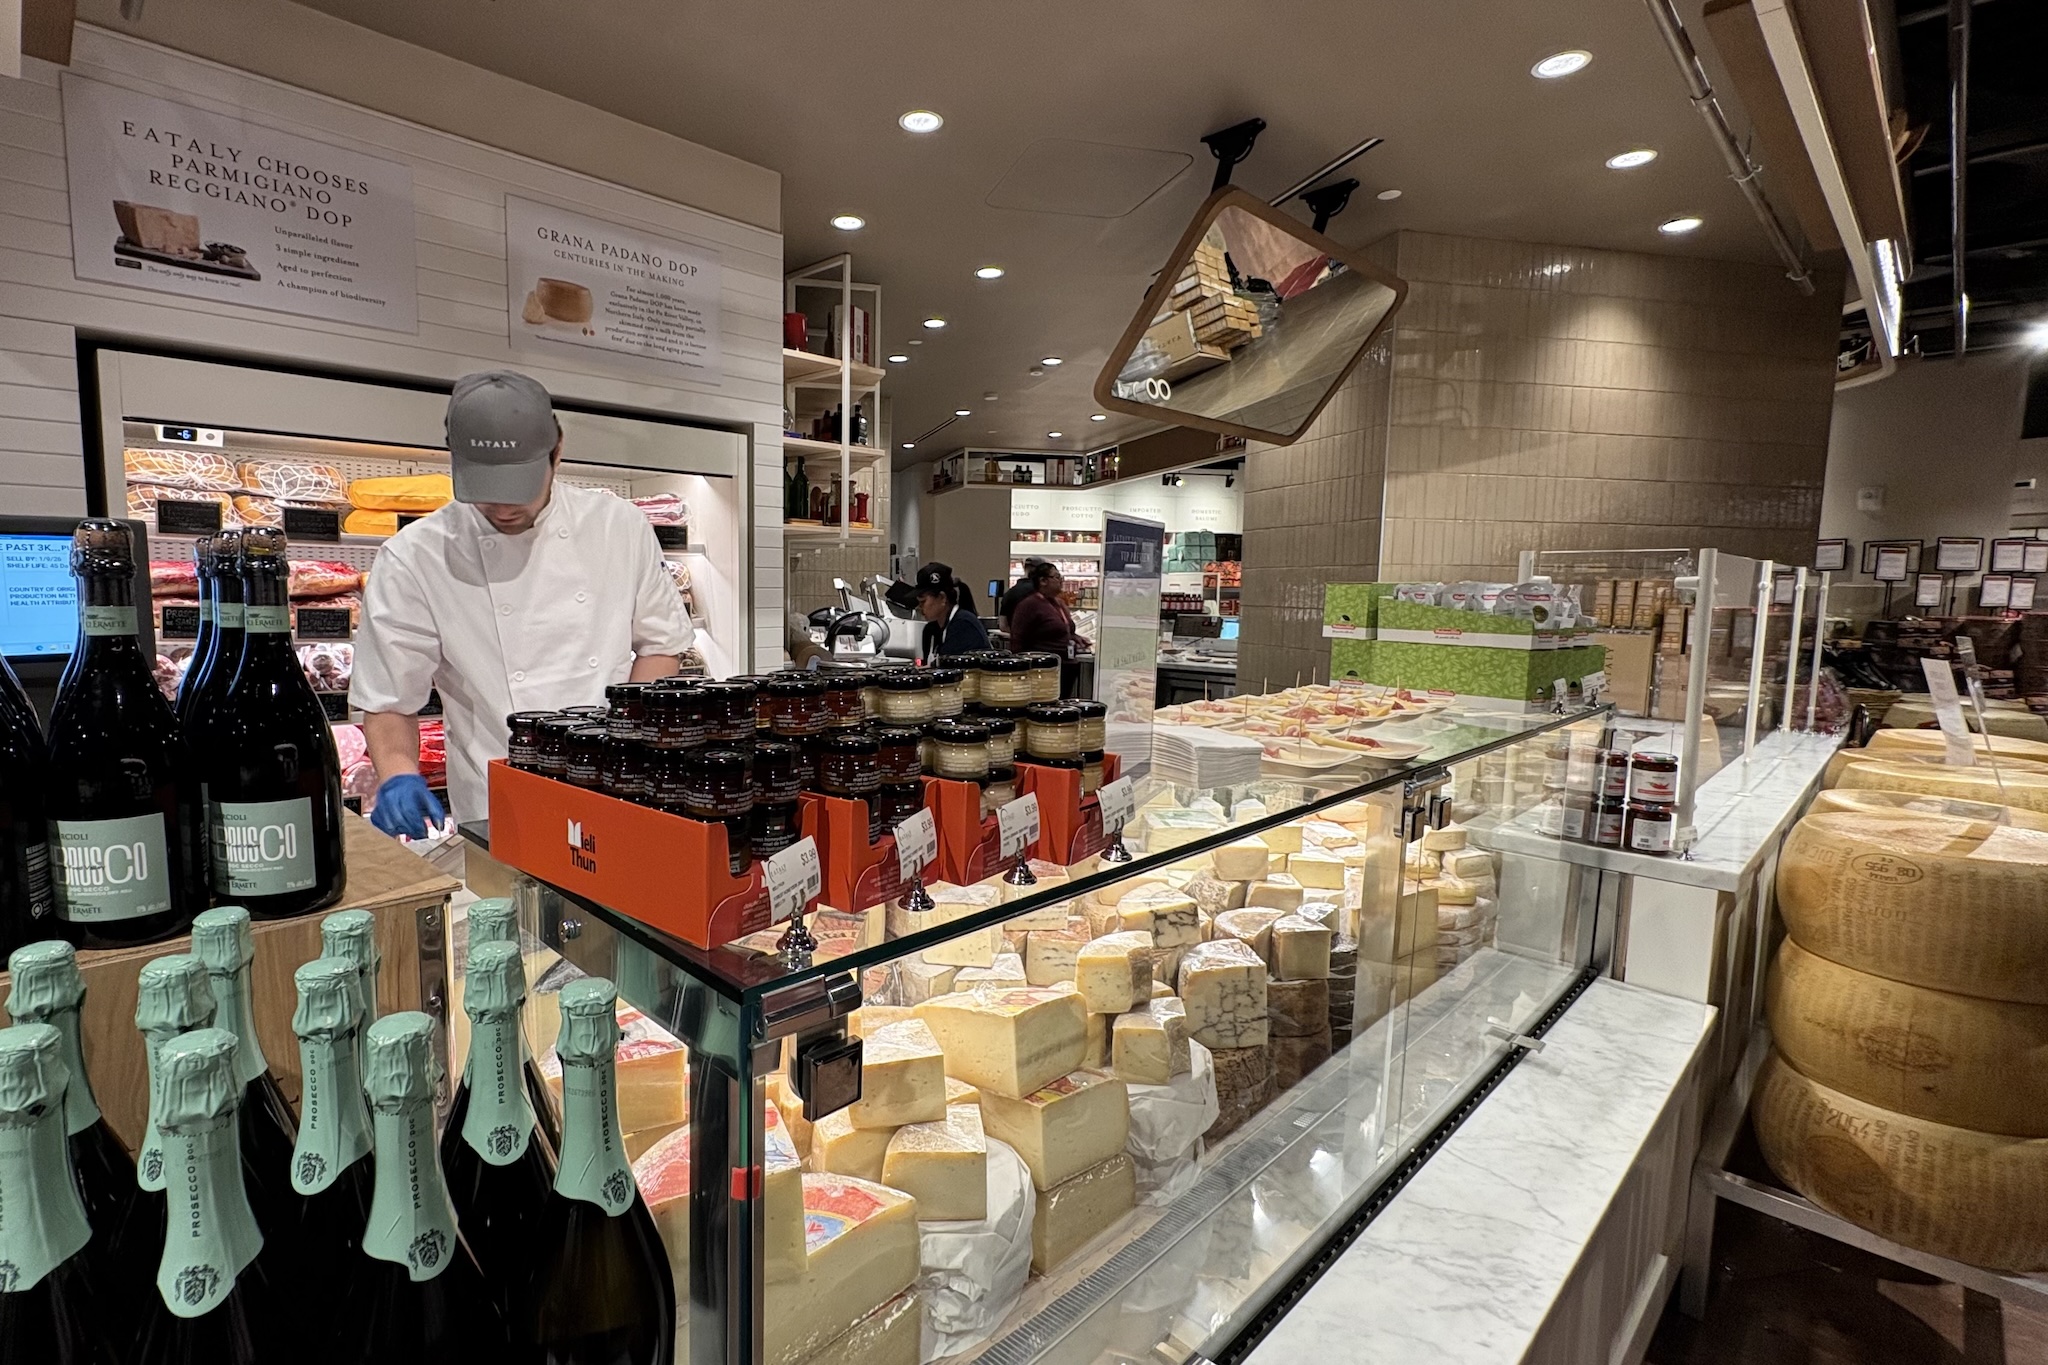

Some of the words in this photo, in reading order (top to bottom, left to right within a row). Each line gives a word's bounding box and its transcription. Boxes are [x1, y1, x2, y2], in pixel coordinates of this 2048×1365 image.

[122, 120, 243, 163] EATALY
[257, 156, 369, 195] CHOOSES
[171, 153, 332, 205] PARMIGIANO
[306, 206, 353, 228] DOP
[274, 226, 328, 244] Unparalleled
[331, 238, 353, 249] flavor
[283, 247, 311, 258] simple
[314, 252, 360, 267] ingredients
[537, 227, 595, 251] GRANA
[601, 242, 663, 268] PADANO
[669, 260, 698, 277] DOP
[276, 262, 297, 272] Aged
[311, 270, 353, 283] perfection
[554, 249, 610, 270] CENTURIES
[613, 263, 624, 272] IN
[627, 266, 646, 278] THE
[649, 272, 685, 287] MAKING
[277, 279, 284, 287] A
[286, 281, 328, 295] champion
[340, 291, 386, 307] biodiversity
[470, 438, 517, 449] EATALY
[6, 543, 35, 551] PAST
[93, 620, 127, 631] ERMETE
[255, 619, 283, 629] ERMETE
[568, 817, 596, 855] Mieli
[570, 846, 597, 874] Thun
[800, 847, 817, 867] $3.99
[83, 885, 110, 893] SECCO
[72, 906, 102, 917] ERMETE
[495, 1046, 506, 1105] PROSECCO
[309, 1068, 318, 1130] PROSECCO
[600, 1089, 612, 1153] PROSECCO
[408, 1140, 422, 1210] PROSECCO
[187, 1165, 201, 1238] PROSECCO
